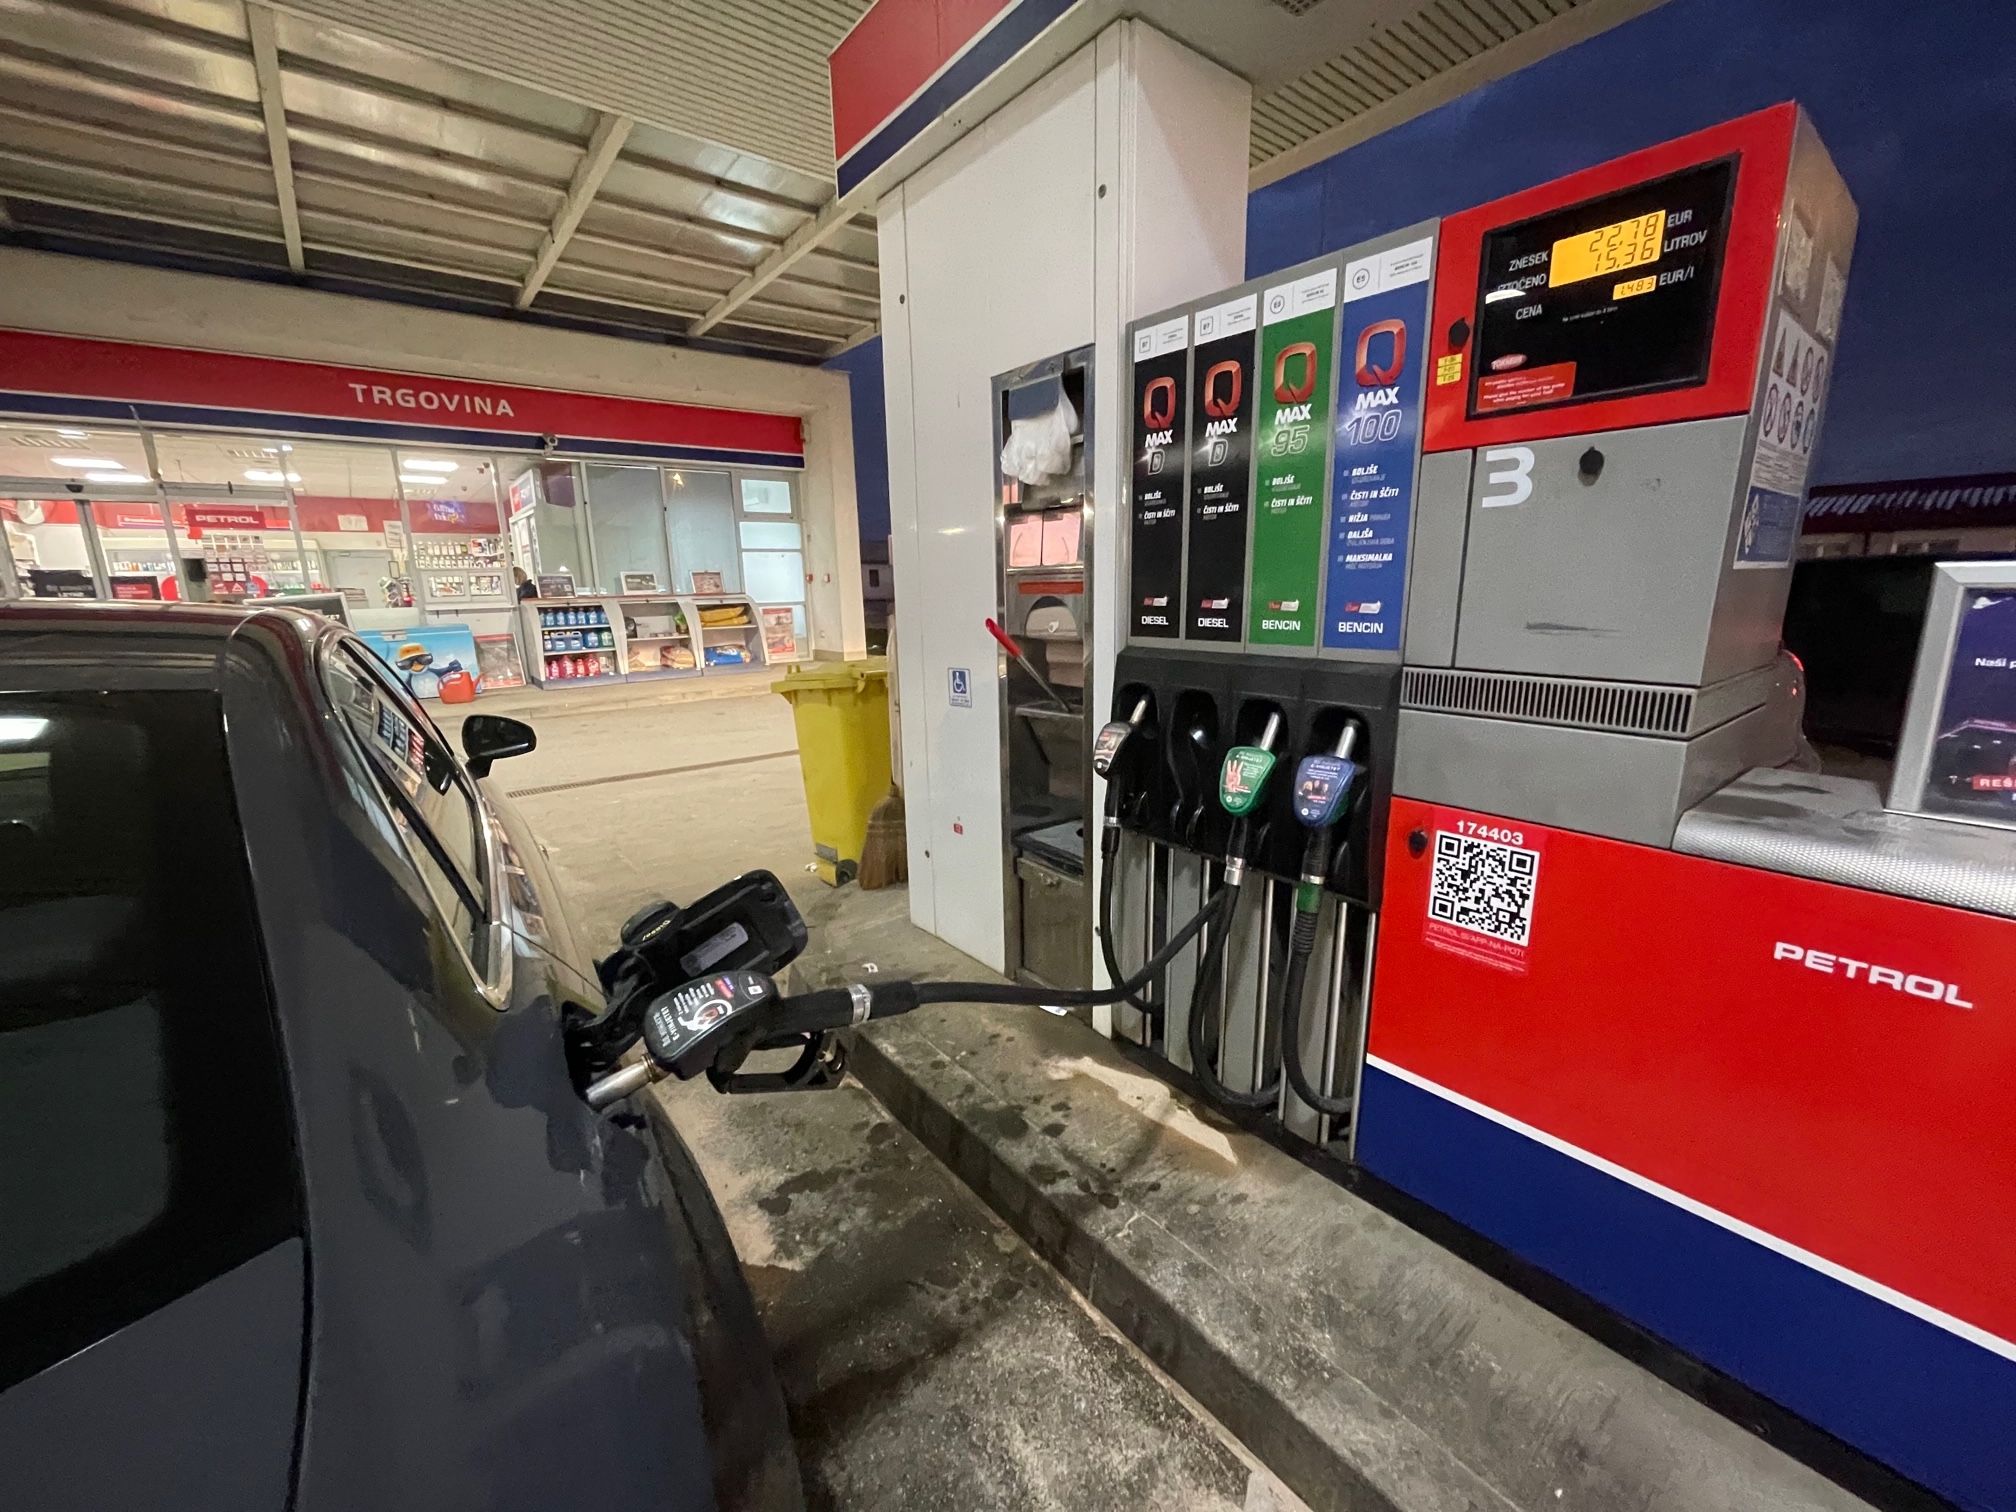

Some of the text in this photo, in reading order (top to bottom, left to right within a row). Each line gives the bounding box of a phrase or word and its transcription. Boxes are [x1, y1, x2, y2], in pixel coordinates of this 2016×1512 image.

[1667, 209, 1693, 228] EUR
[1664, 230, 1708, 252] LITROV
[1509, 250, 1550, 272] ZNESEK
[1515, 304, 1543, 321] CENA
[1356, 319, 1406, 386] Q
[1274, 342, 1317, 403] Q
[1205, 360, 1241, 417] Q
[1355, 386, 1400, 411] MAX
[348, 383, 514, 418] TRGOVINA
[1144, 376, 1176, 429] Q
[1275, 404, 1312, 425] MAX
[1205, 418, 1238, 437] MAX
[1345, 410, 1402, 445] 100
[1145, 430, 1173, 448] MAX
[1271, 425, 1310, 456] 95
[1148, 449, 1165, 475] D
[1208, 439, 1228, 467] D
[1352, 464, 1379, 476] BOLJŠE
[1482, 446, 1535, 508] 3
[1350, 486, 1399, 500] ČISTI IN ŠČITI
[195, 514, 259, 525] PETROL
[1348, 512, 1368, 522] NIŽJA
[1345, 552, 1393, 563] MAKSIMALNA
[1141, 615, 1169, 626] DIESEL
[1197, 617, 1229, 628] DIESEL
[1262, 619, 1301, 631] BENCIN
[1338, 621, 1384, 634] BENCIN
[1975, 656, 2007, 669] Naši
[1456, 820, 1524, 846] 174403
[1773, 941, 1973, 1009] PETROL
